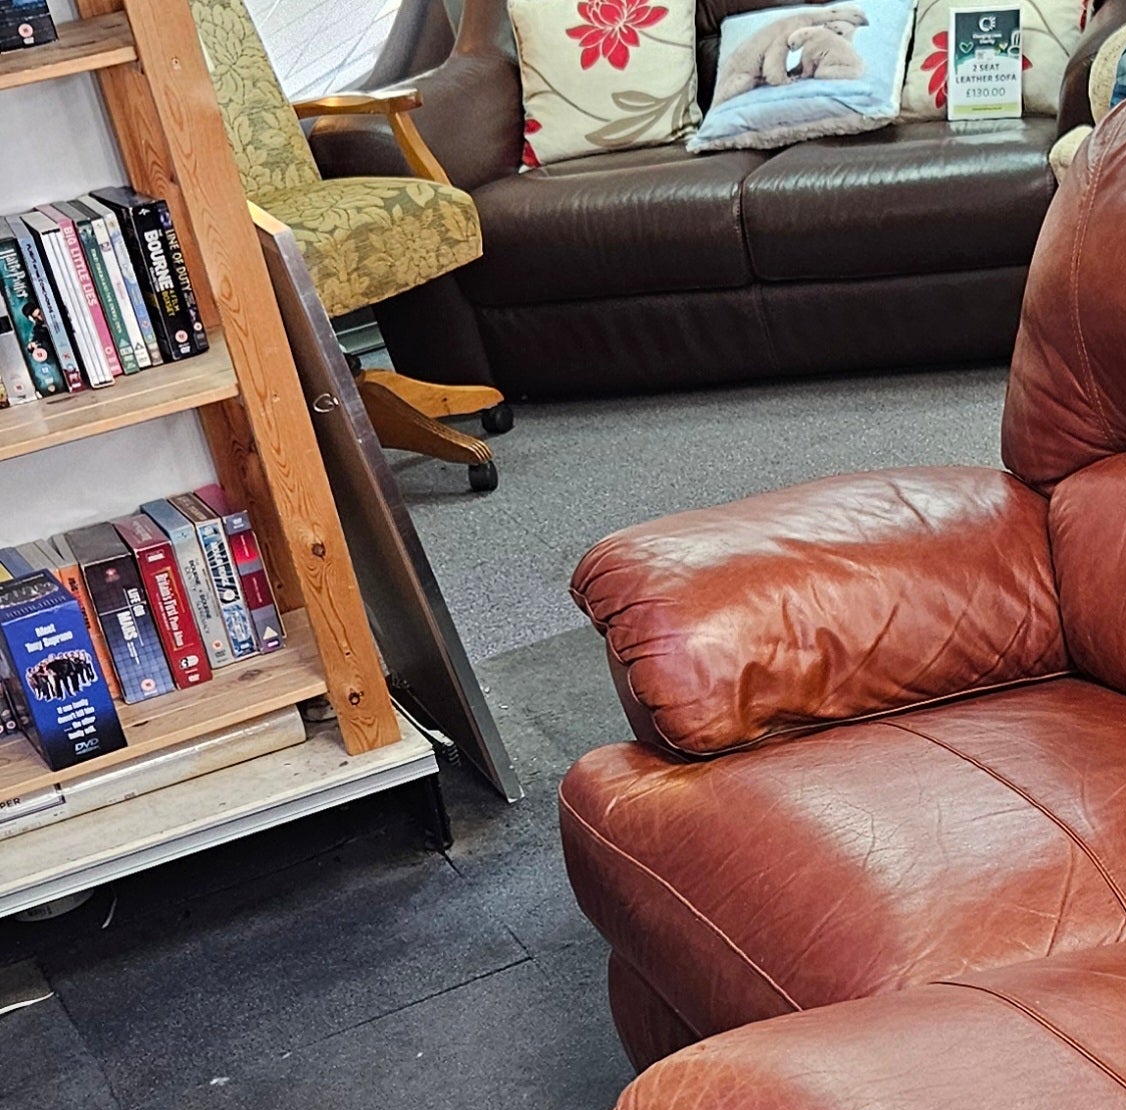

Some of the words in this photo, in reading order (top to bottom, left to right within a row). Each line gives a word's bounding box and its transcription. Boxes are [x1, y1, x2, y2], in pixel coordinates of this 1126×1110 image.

[980, 63, 1000, 71] SEAT
[956, 75, 992, 84] LEATHER
[966, 87, 1006, 98] £130.00
[165, 228, 178, 249] LINE
[63, 227, 75, 245] BIG
[70, 249, 89, 282] LITTLE
[83, 282, 97, 306] LIES
[143, 228, 174, 292] BOURNE
[171, 251, 183, 266] OF
[176, 266, 192, 292] DUTY
[127, 587, 141, 604] LIFE
[163, 598, 179, 617] First
[116, 610, 138, 641] MARS
[75, 738, 99, 752] DVD
